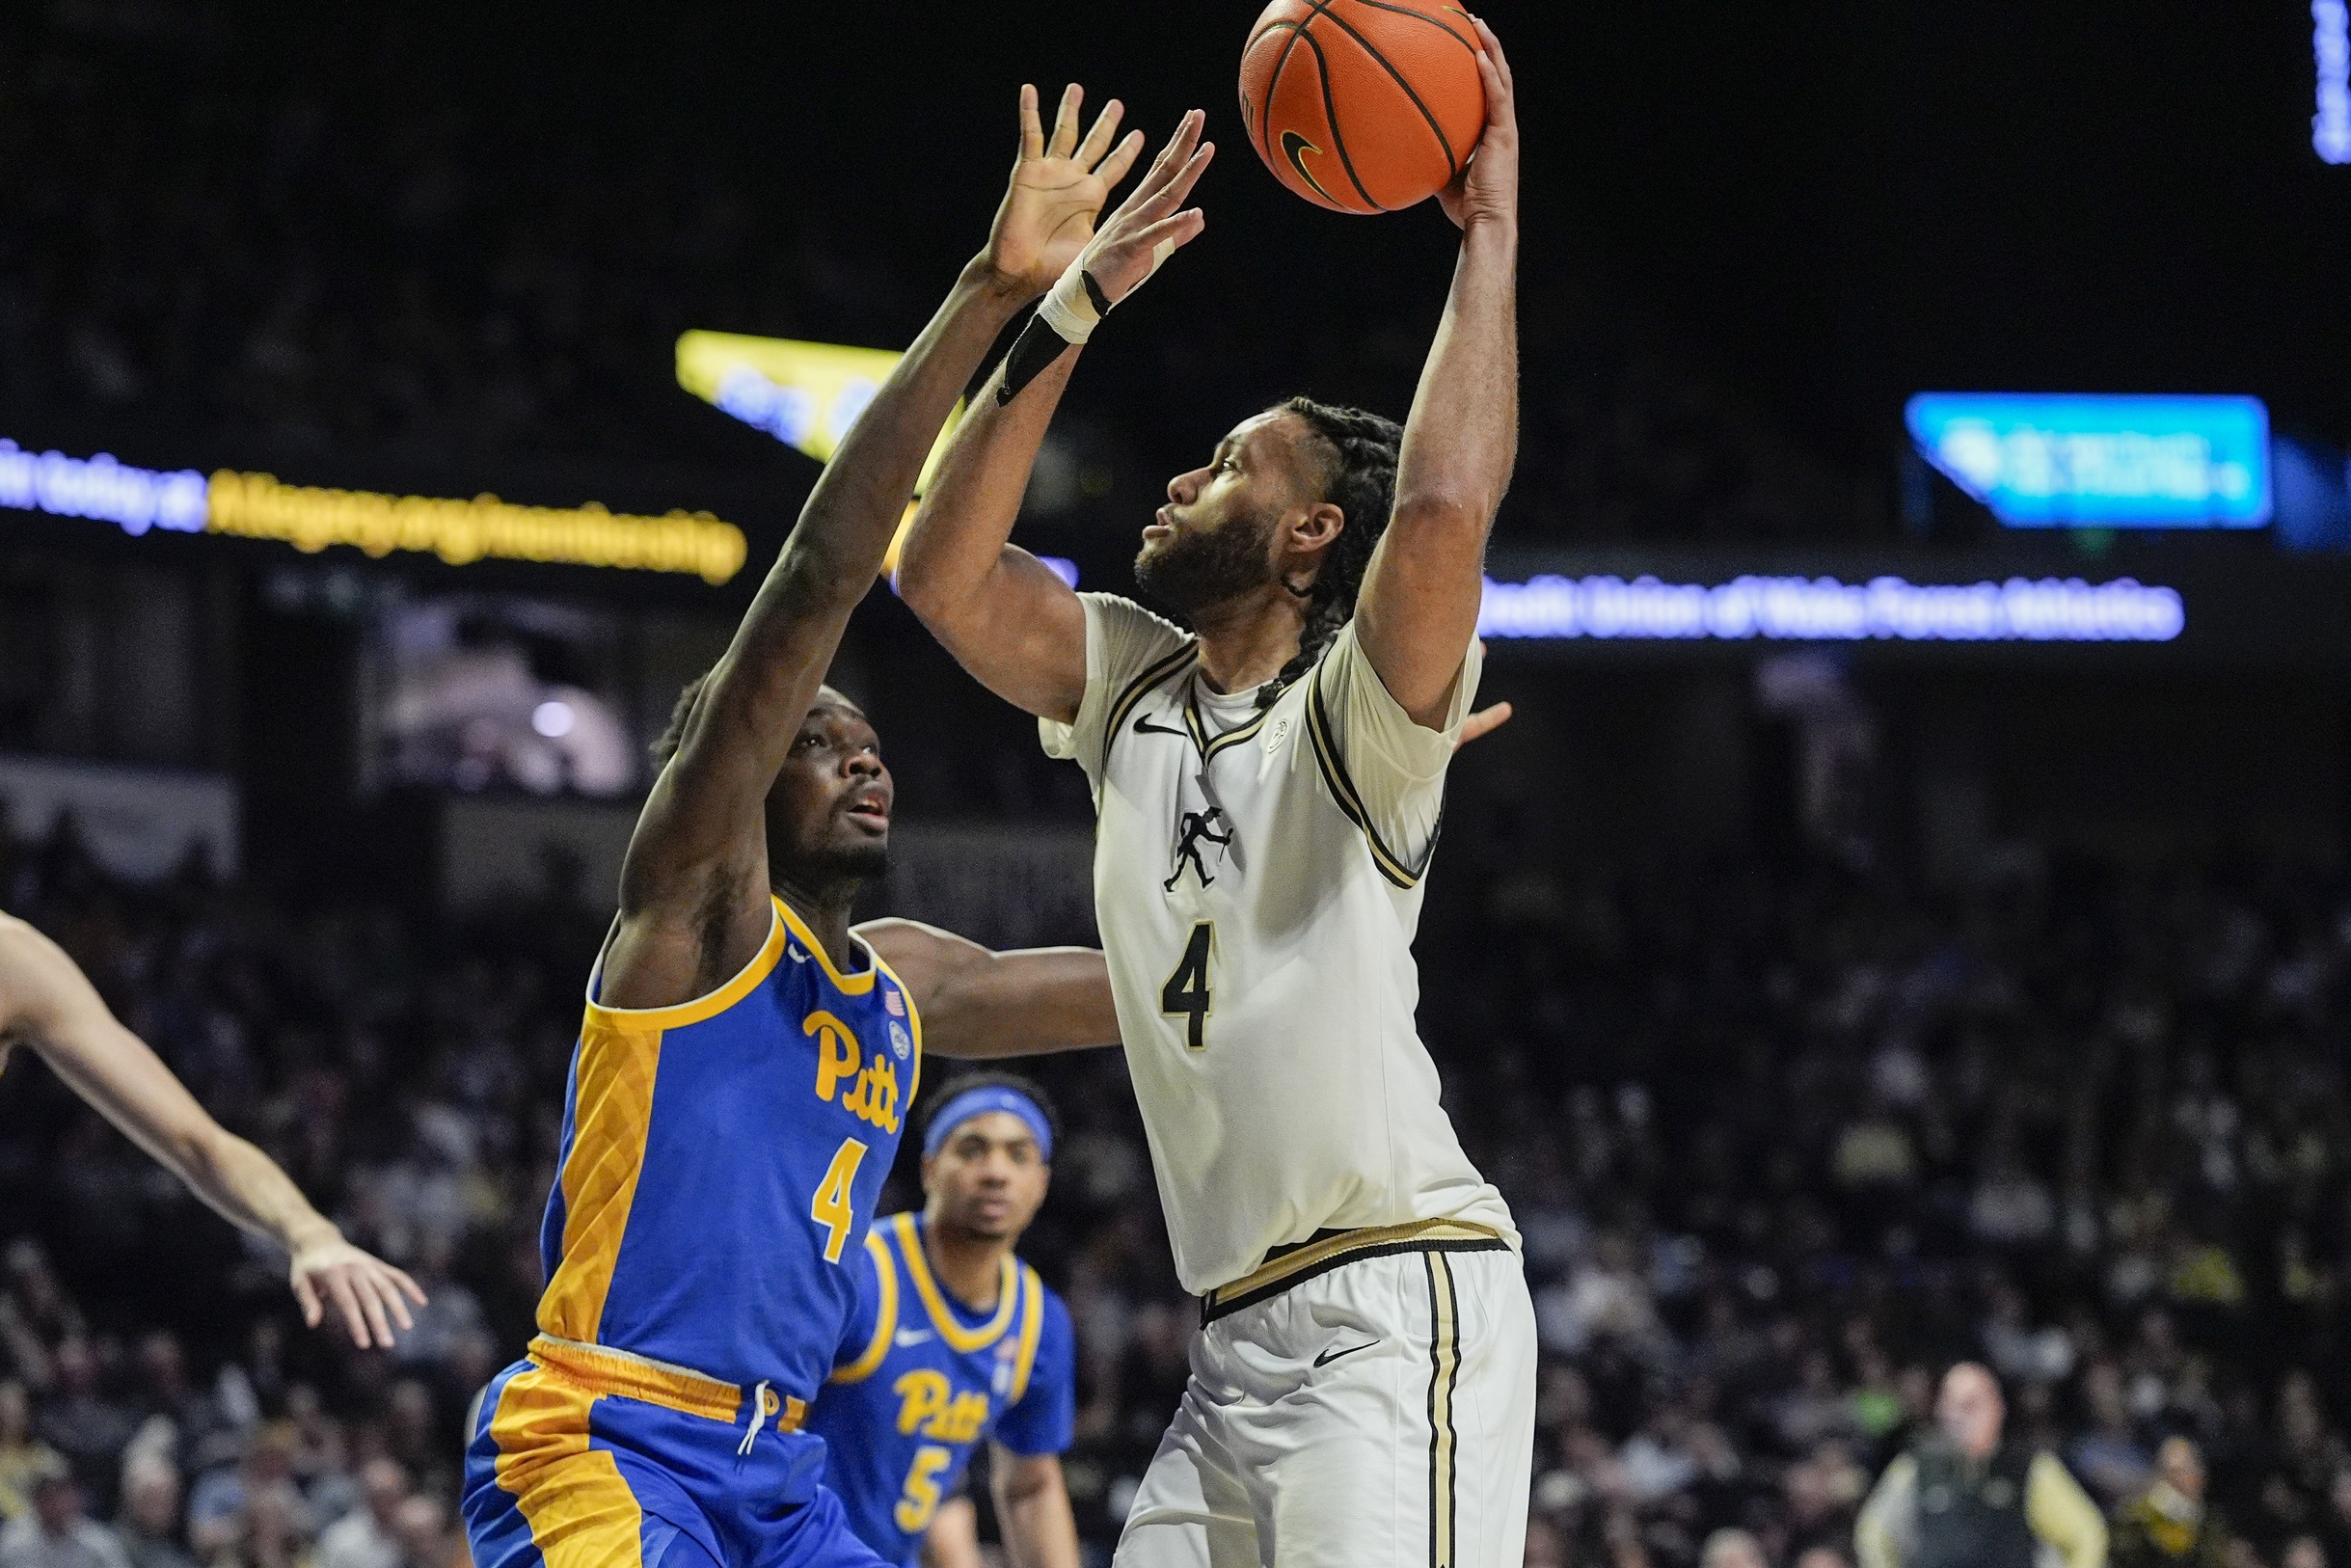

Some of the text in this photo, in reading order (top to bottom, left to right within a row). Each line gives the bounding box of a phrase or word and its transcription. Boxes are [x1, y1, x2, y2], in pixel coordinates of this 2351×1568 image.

[1160, 921, 1214, 1051] 4
[803, 1011, 899, 1134] Pitt
[811, 1137, 868, 1264] 4
[893, 1368, 989, 1444] Pitt
[894, 1446, 952, 1533] 5
